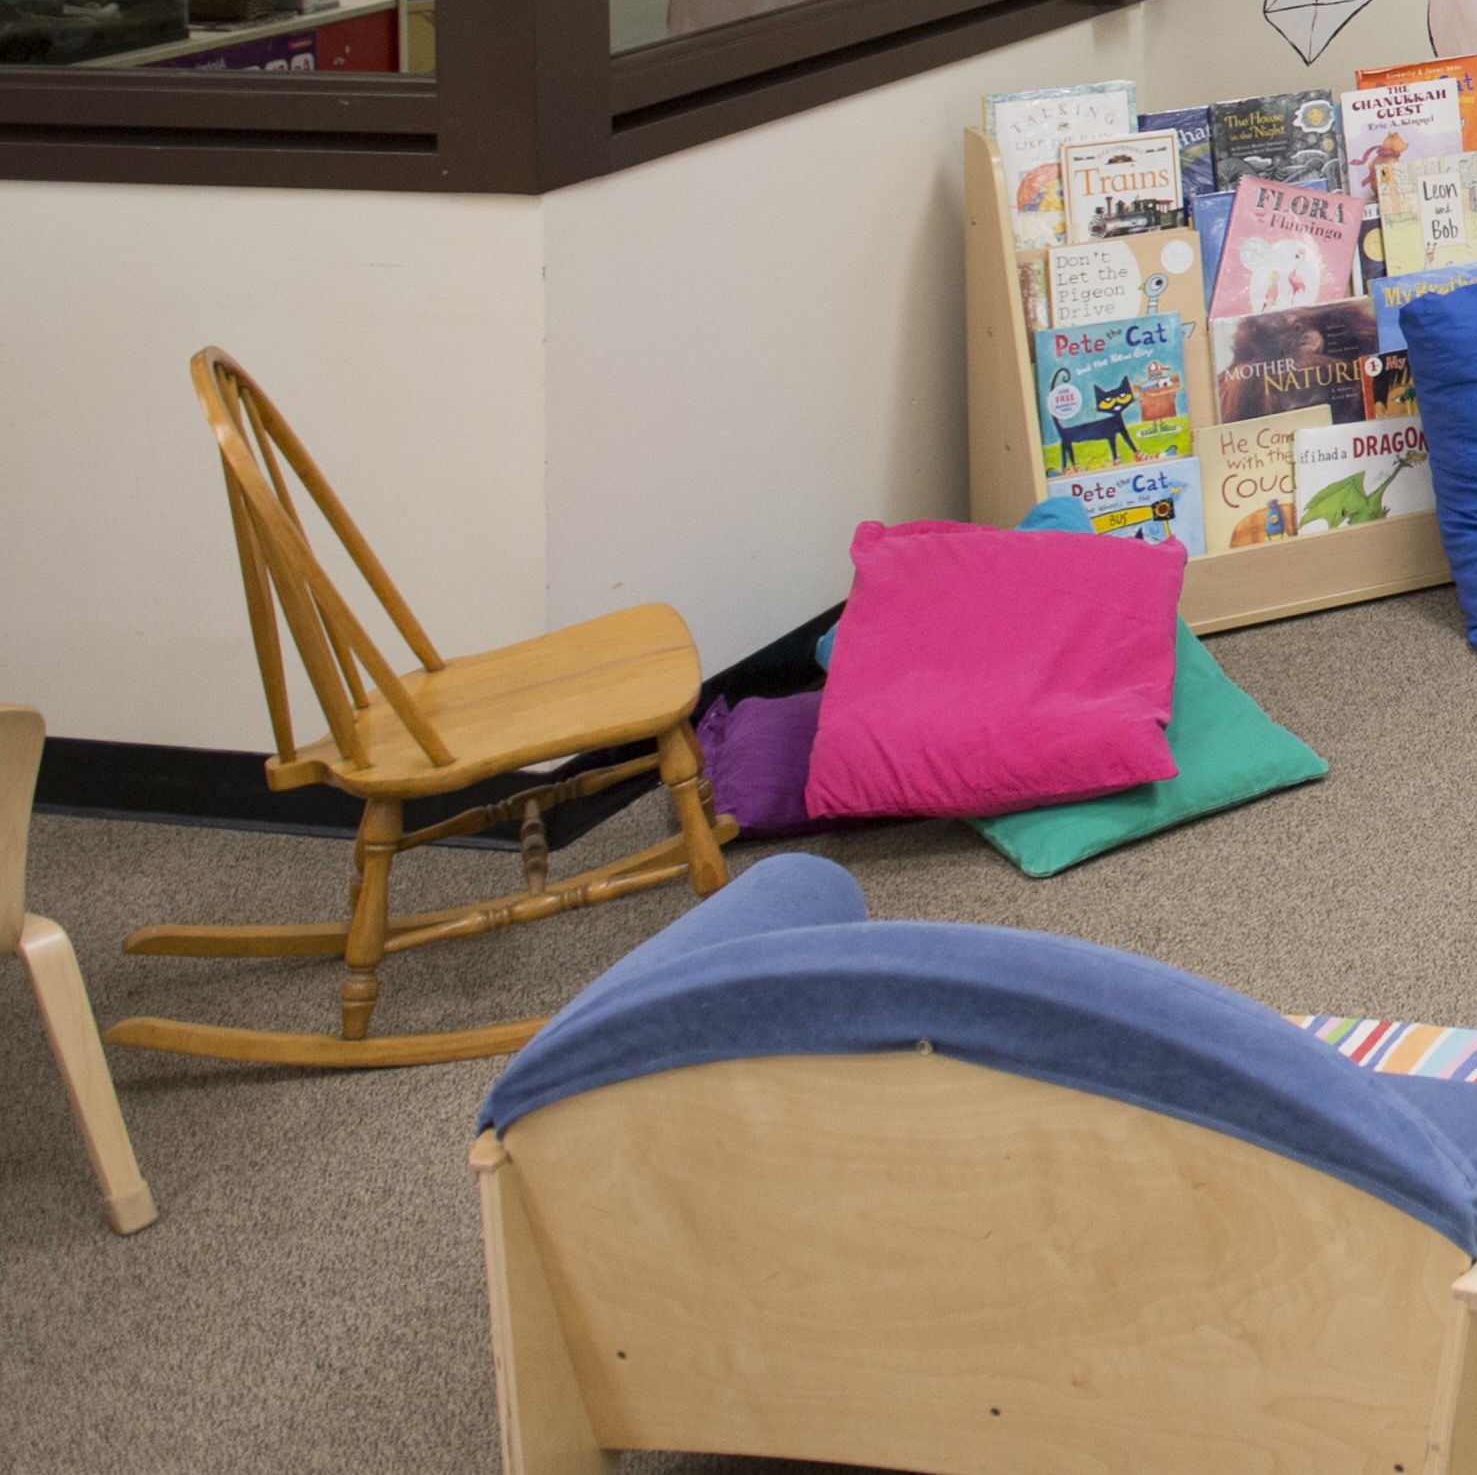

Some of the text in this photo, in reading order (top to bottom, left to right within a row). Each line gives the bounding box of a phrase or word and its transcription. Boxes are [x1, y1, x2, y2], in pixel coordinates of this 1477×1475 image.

[1352, 89, 1446, 111] CHANUKKAH
[1388, 85, 1410, 95] THE
[1010, 104, 1116, 134] TALKING
[1224, 111, 1285, 128] The House
[1377, 104, 1423, 119] GUEST
[1368, 121, 1387, 131] Eric
[1401, 115, 1434, 127] Kimmel
[1179, 123, 1212, 150] hat
[1229, 125, 1286, 142] in the Night
[1074, 163, 1169, 196] Trains
[1423, 181, 1458, 201] Leon
[1256, 187, 1346, 225] FLORA
[1435, 205, 1452, 215] and
[1270, 213, 1342, 241] Flamingo
[1432, 217, 1459, 240] Bob
[1056, 252, 1110, 269] Don't
[1057, 267, 1128, 286] Let the
[1059, 285, 1125, 303] Pigeon
[1059, 302, 1116, 321] Drive
[1055, 323, 1168, 357] Pete the Cat
[1110, 353, 1132, 363] New
[1133, 347, 1153, 358] Guy
[1385, 356, 1407, 371] My
[1225, 357, 1297, 382] MOTHER
[1264, 361, 1362, 395] NATURE
[1055, 393, 1075, 404] FREE
[1220, 428, 1295, 455] He Cam
[1300, 451, 1309, 464] if
[1317, 447, 1339, 462] had
[1340, 450, 1348, 460] a
[1352, 426, 1429, 459] DRAGON
[1227, 447, 1293, 471] with the
[1072, 482, 1116, 502] Pete
[1132, 472, 1169, 493] Cat
[1109, 511, 1128, 526] BUS
